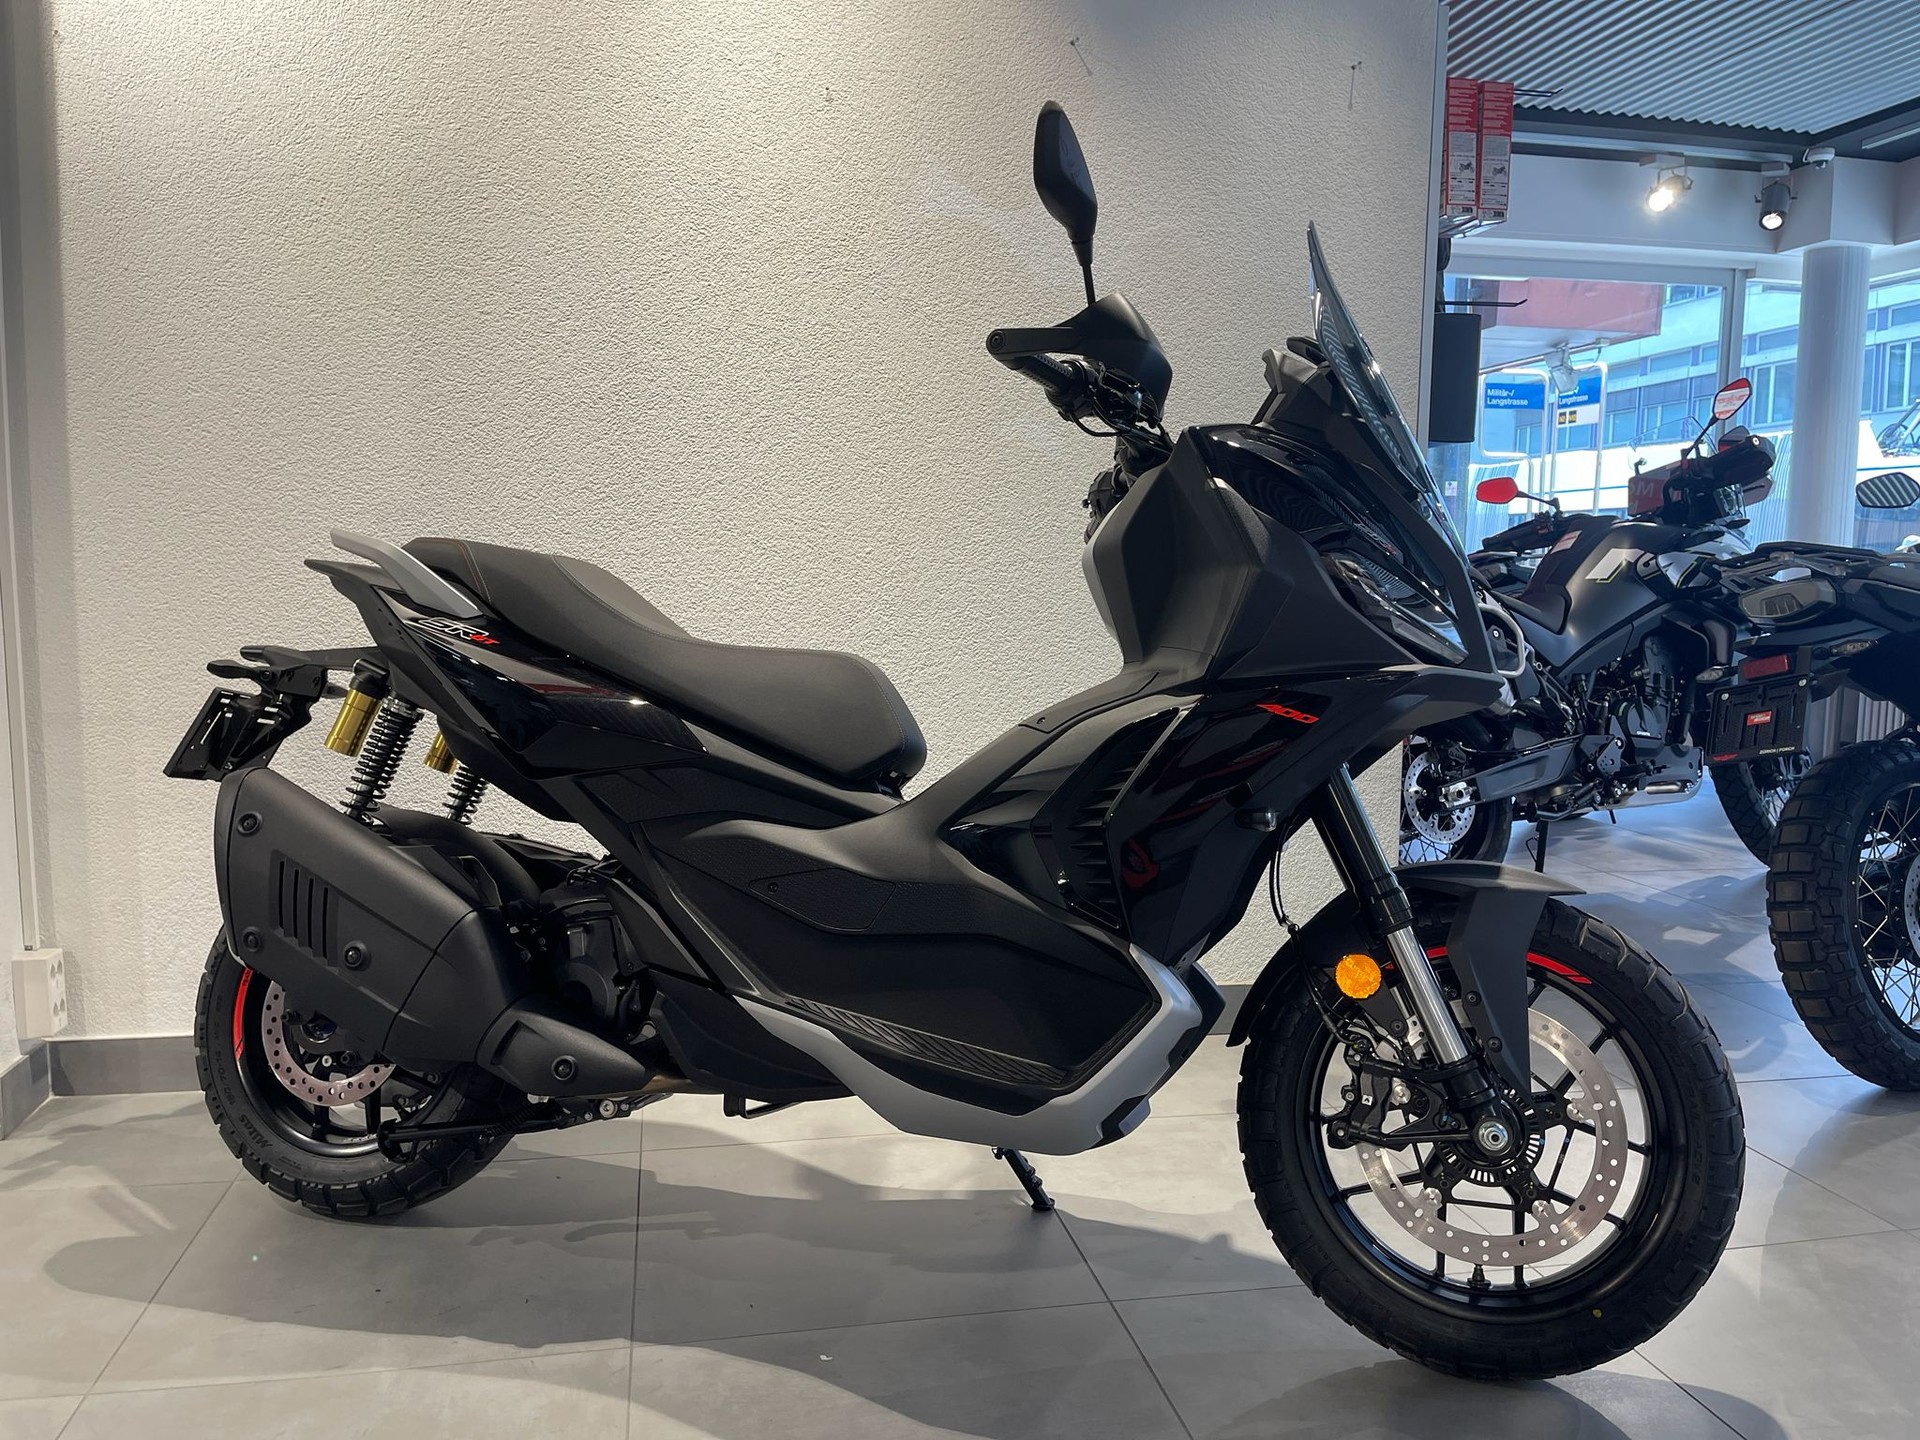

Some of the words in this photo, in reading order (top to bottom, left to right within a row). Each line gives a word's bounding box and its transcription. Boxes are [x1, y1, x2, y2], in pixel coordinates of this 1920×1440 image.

[1487, 388, 1515, 397] Militär-/
[1487, 397, 1529, 407] Langstrasse
[1559, 394, 1589, 406] Langstrasse
[1256, 703, 1320, 724] 400
[238, 1113, 274, 1149] Mitas
